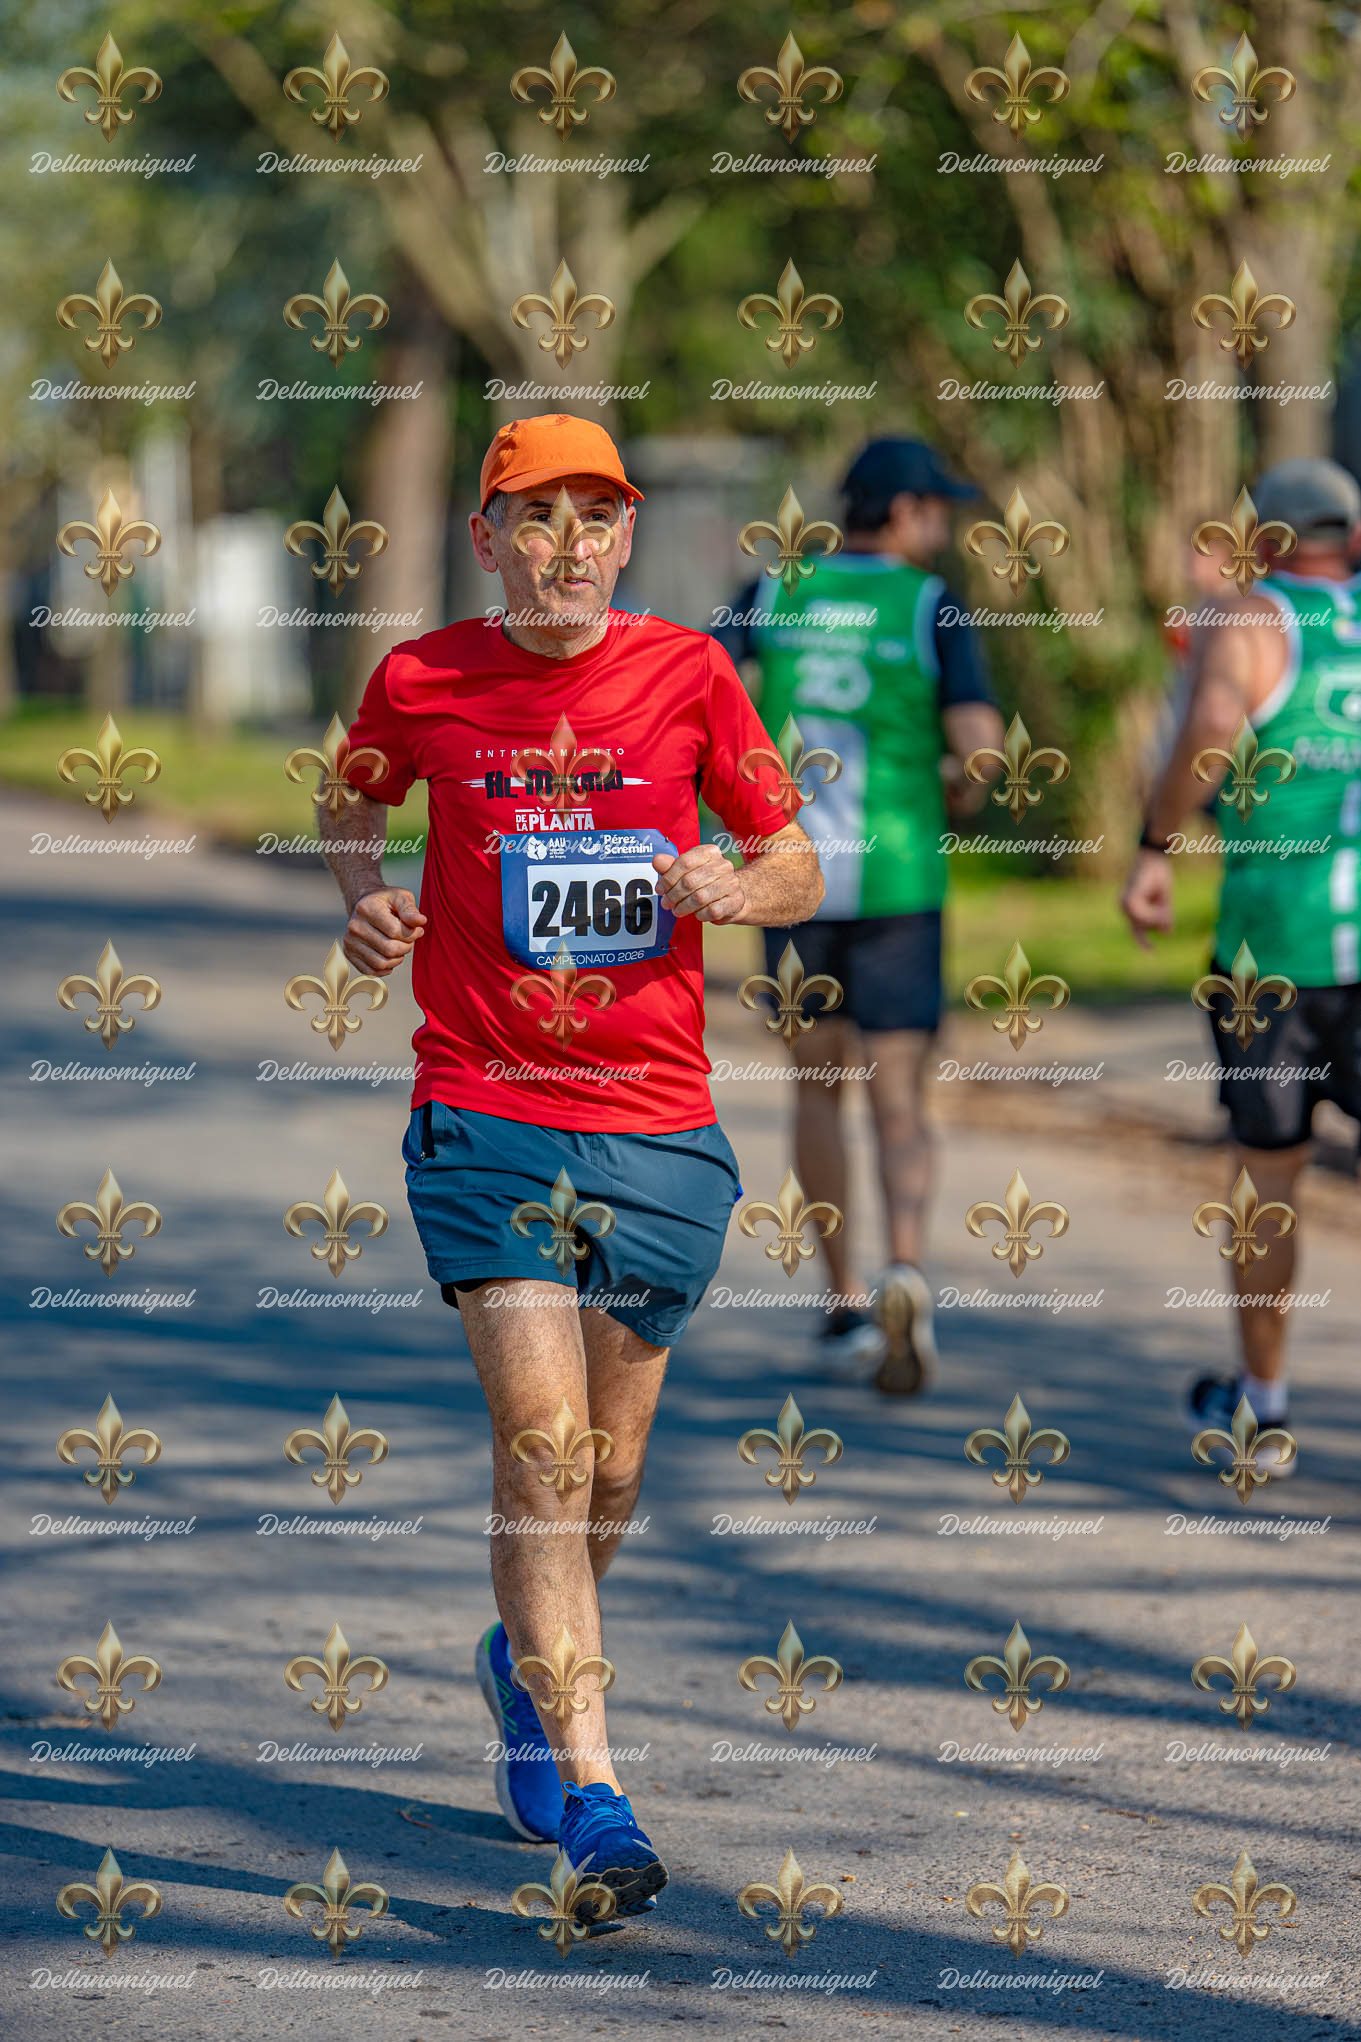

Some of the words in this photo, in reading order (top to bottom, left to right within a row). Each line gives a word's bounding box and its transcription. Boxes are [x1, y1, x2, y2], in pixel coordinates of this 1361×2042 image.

[475, 748, 625, 759] ENTRENAMIENTO
[515, 814, 527, 823] DE
[528, 812, 595, 832] PLANTA
[516, 822, 529, 832] LA
[548, 837, 566, 848] AAU
[603, 834, 637, 845] Pérez
[603, 842, 654, 854] Scremini
[531, 878, 654, 938] 2466
[536, 952, 616, 966] CAMPEONATO
[617, 950, 646, 962] 2026
